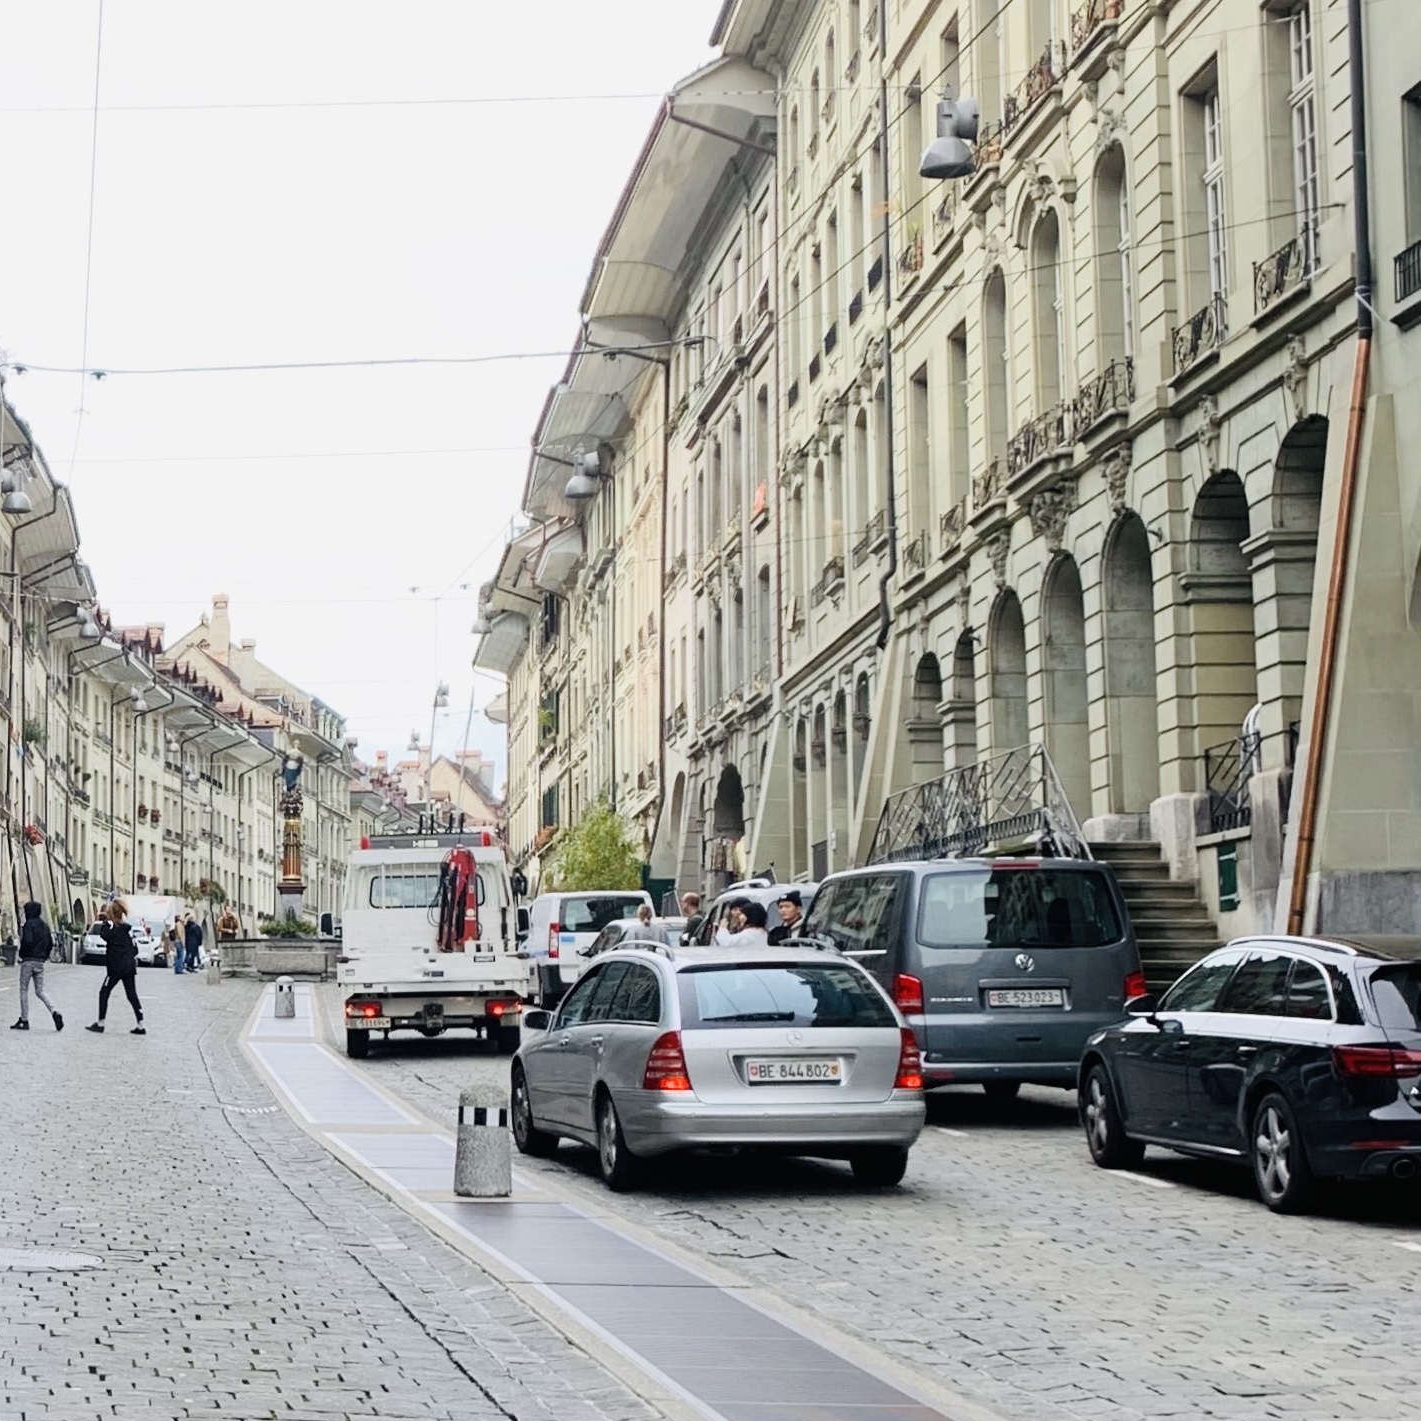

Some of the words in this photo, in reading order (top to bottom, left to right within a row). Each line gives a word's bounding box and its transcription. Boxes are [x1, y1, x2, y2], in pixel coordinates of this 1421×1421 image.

[997, 992, 1011, 1004] BE
[759, 1064, 776, 1079] BE
[780, 1064, 831, 1079] 844802
